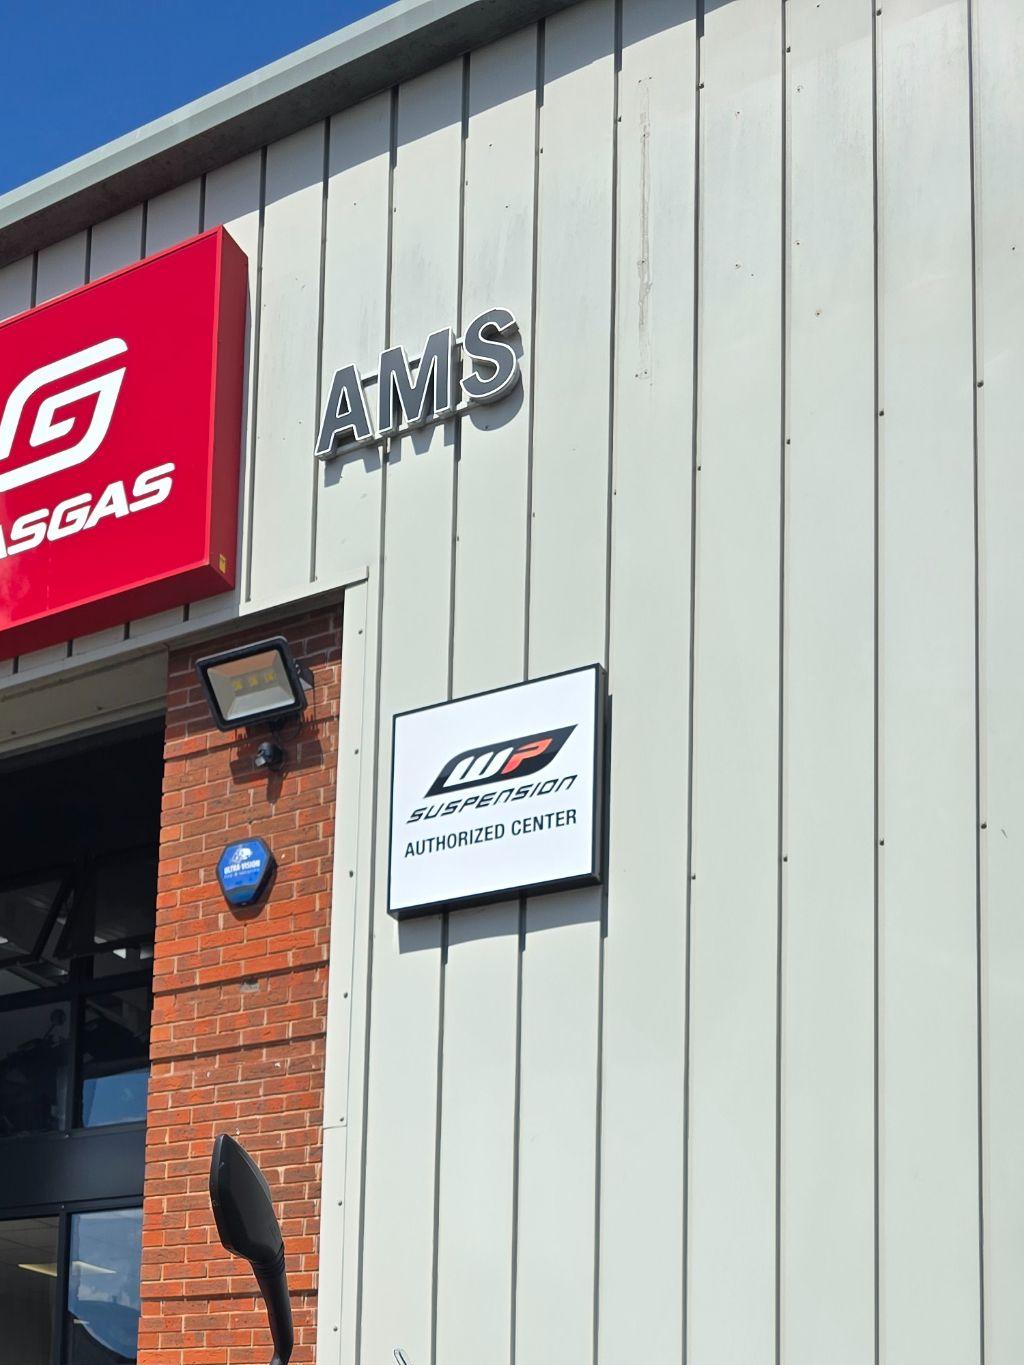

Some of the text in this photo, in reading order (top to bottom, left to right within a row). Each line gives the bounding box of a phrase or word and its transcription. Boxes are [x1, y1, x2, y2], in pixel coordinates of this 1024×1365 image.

[314, 306, 517, 457] AMS
[405, 774, 579, 825] SUSPENSION
[404, 808, 578, 859] AUTHORIZED CENTER
